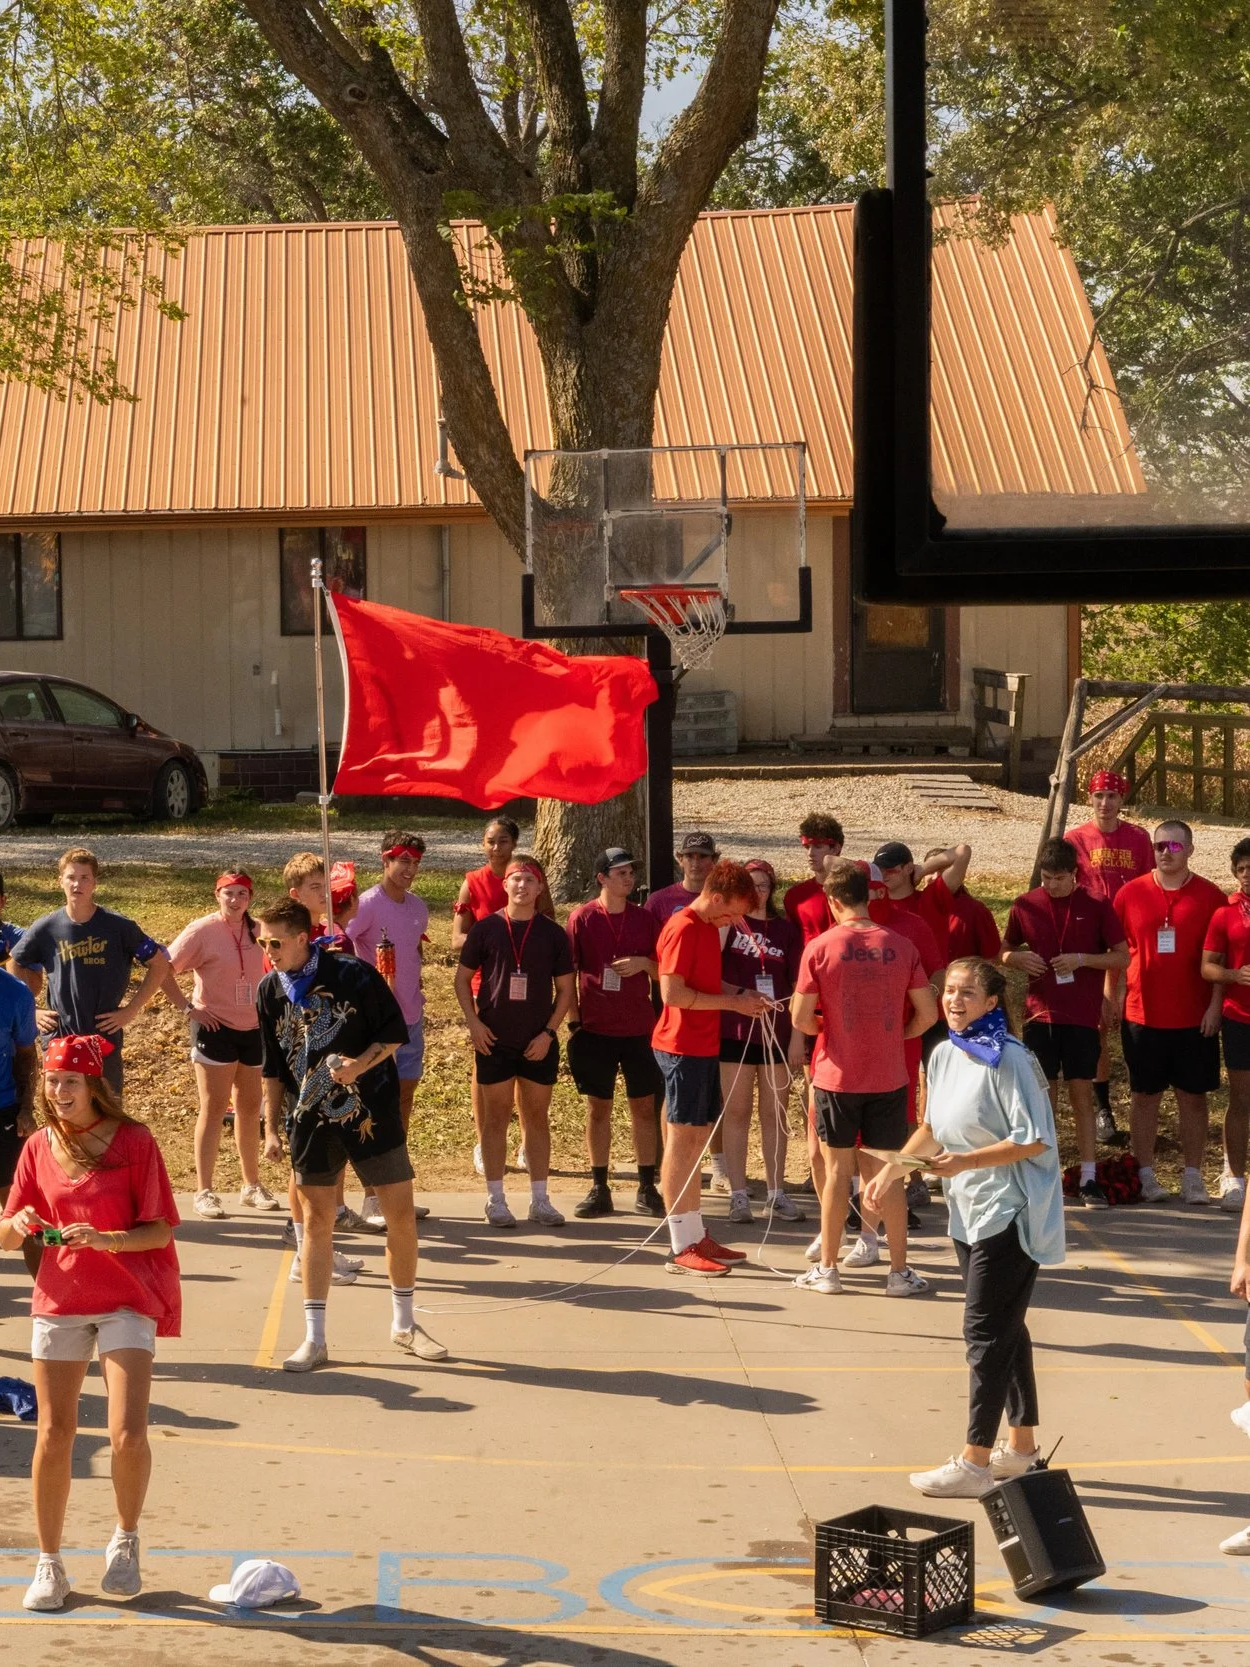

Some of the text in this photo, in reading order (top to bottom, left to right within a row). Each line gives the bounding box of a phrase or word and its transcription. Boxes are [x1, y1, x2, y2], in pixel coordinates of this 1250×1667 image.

[1090, 858, 1136, 869] CYCLONE
[56, 936, 108, 965] Howler
[840, 942, 896, 965] Jeep
[83, 957, 106, 965] BROS
